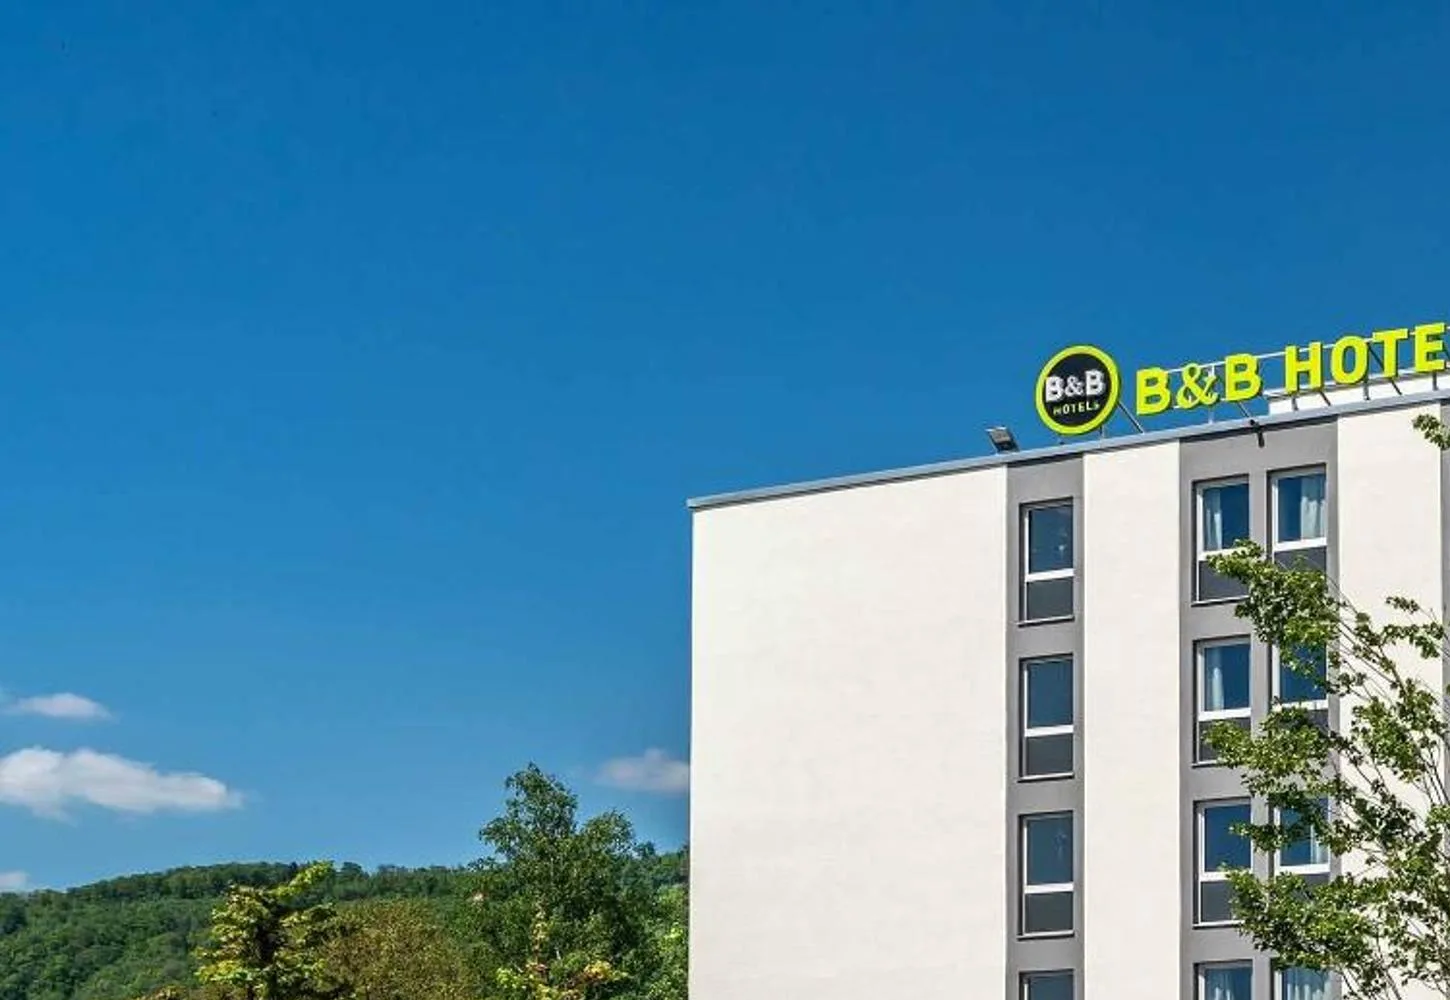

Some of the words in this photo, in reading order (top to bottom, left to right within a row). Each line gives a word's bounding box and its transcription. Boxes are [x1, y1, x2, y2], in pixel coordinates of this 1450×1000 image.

[1045, 369, 1106, 402] B&B
[1136, 352, 1263, 415] B&B
[1053, 401, 1099, 416] HOTELS
